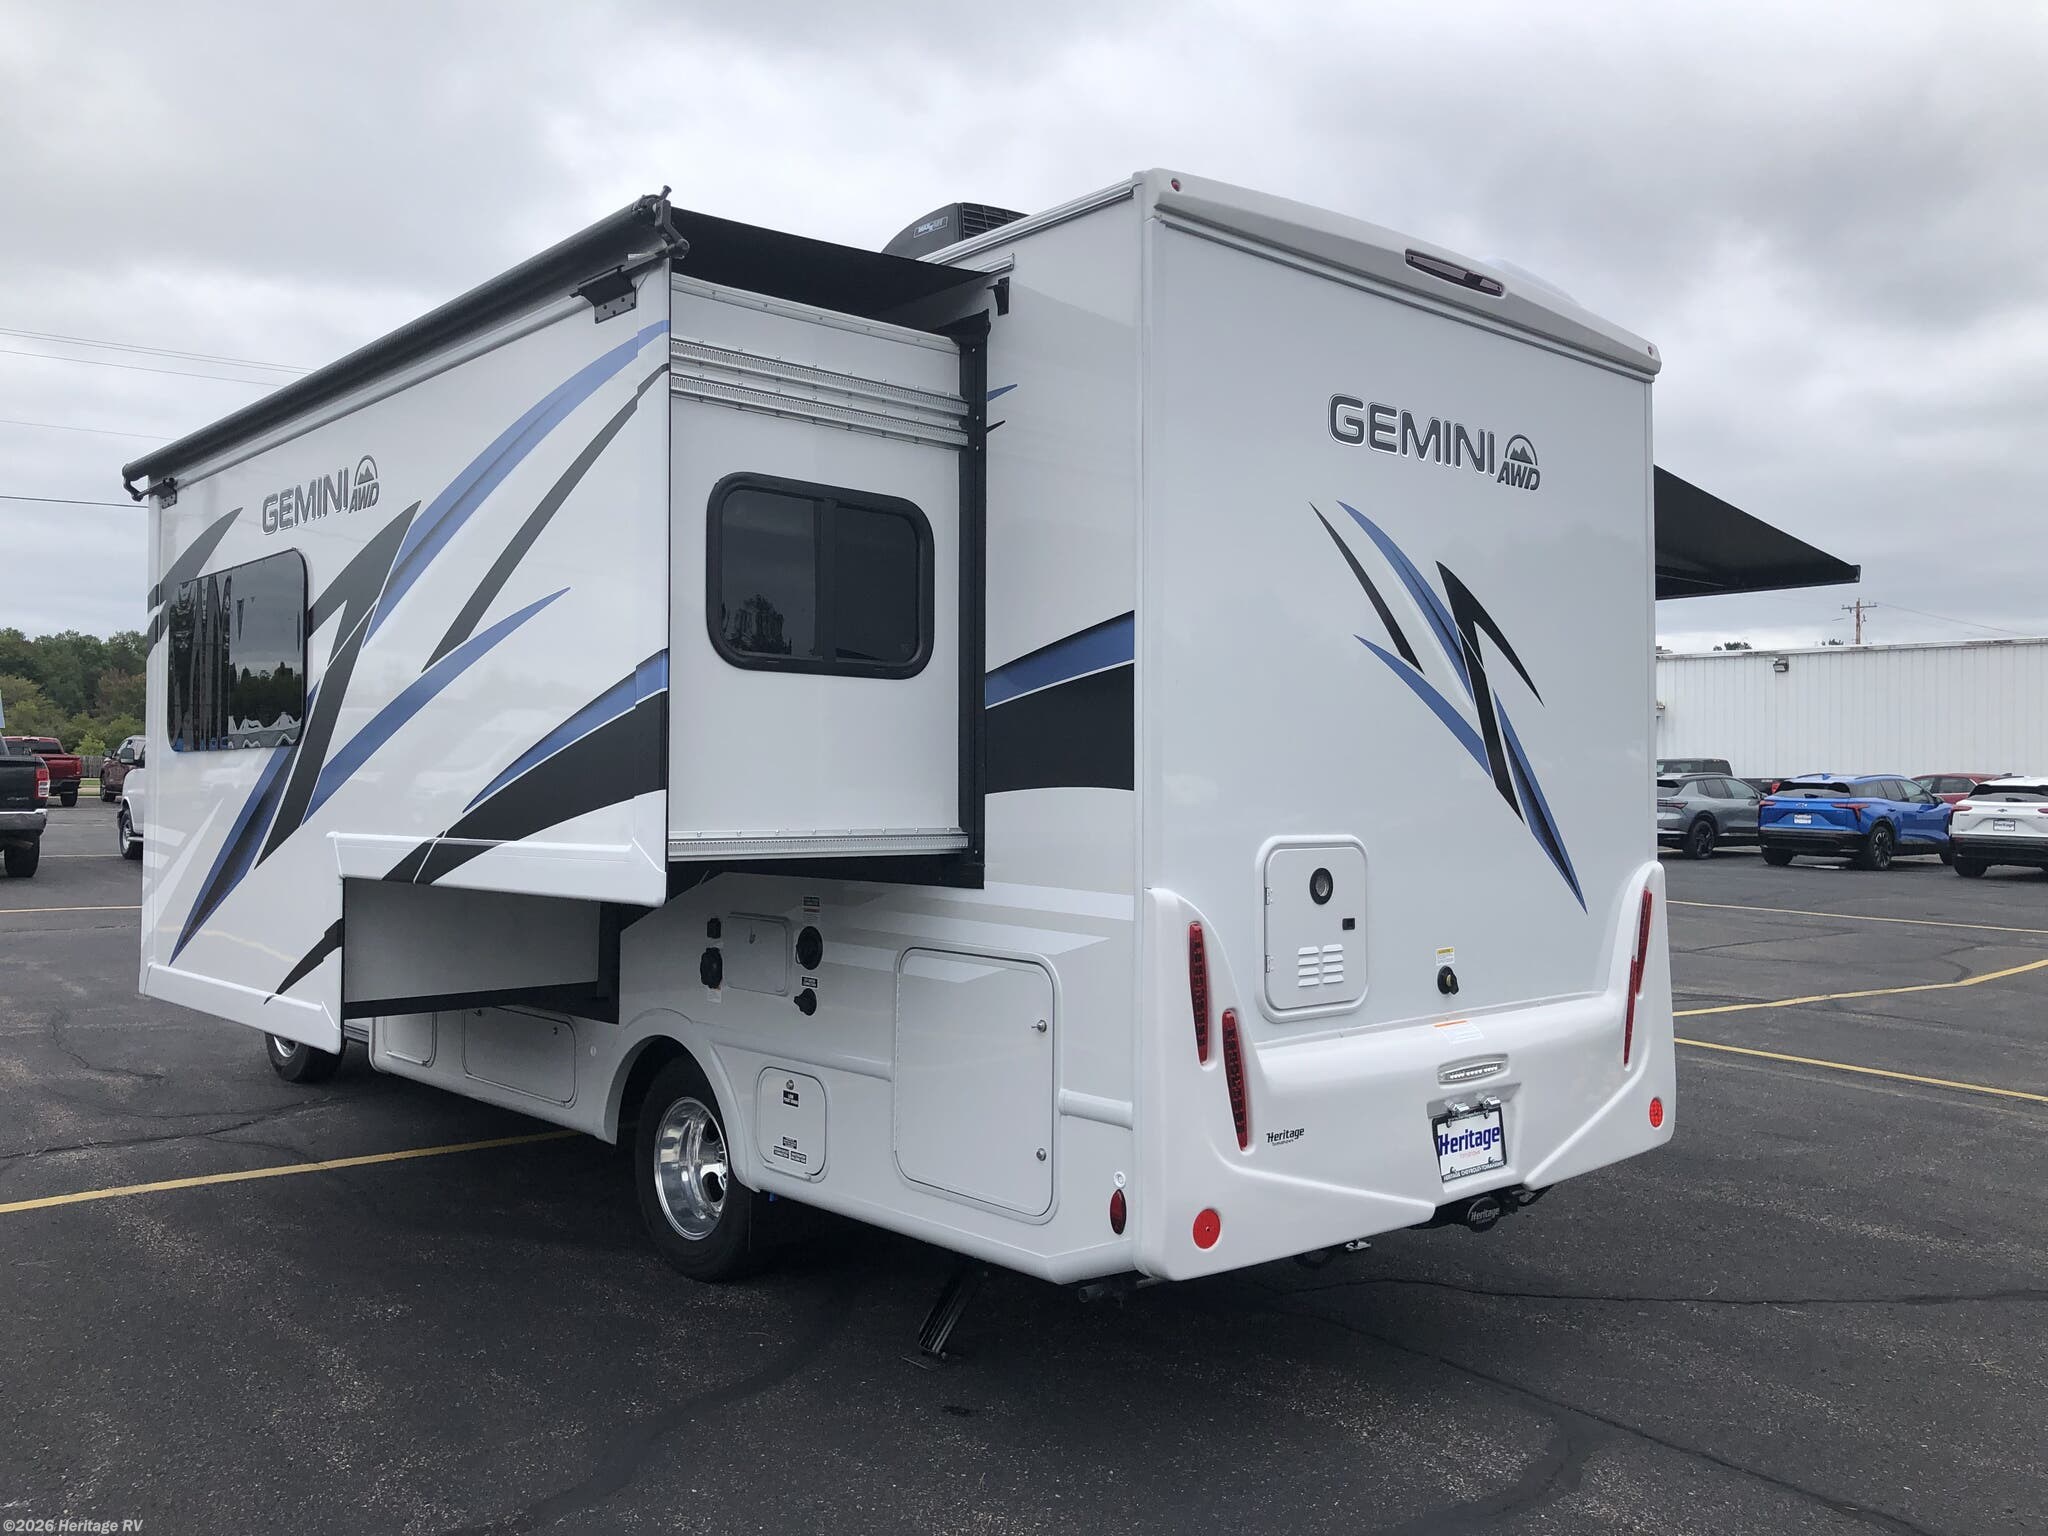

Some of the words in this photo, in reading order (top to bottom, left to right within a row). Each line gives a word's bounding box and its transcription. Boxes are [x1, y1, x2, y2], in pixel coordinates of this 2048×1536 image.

[1328, 393, 1495, 476] GEMINI
[1497, 461, 1541, 491] AWD
[262, 466, 349, 535] GEMINI
[348, 481, 380, 514] AWD
[1266, 1128, 1305, 1143] Heritage
[1438, 1127, 1500, 1156] Heritage
